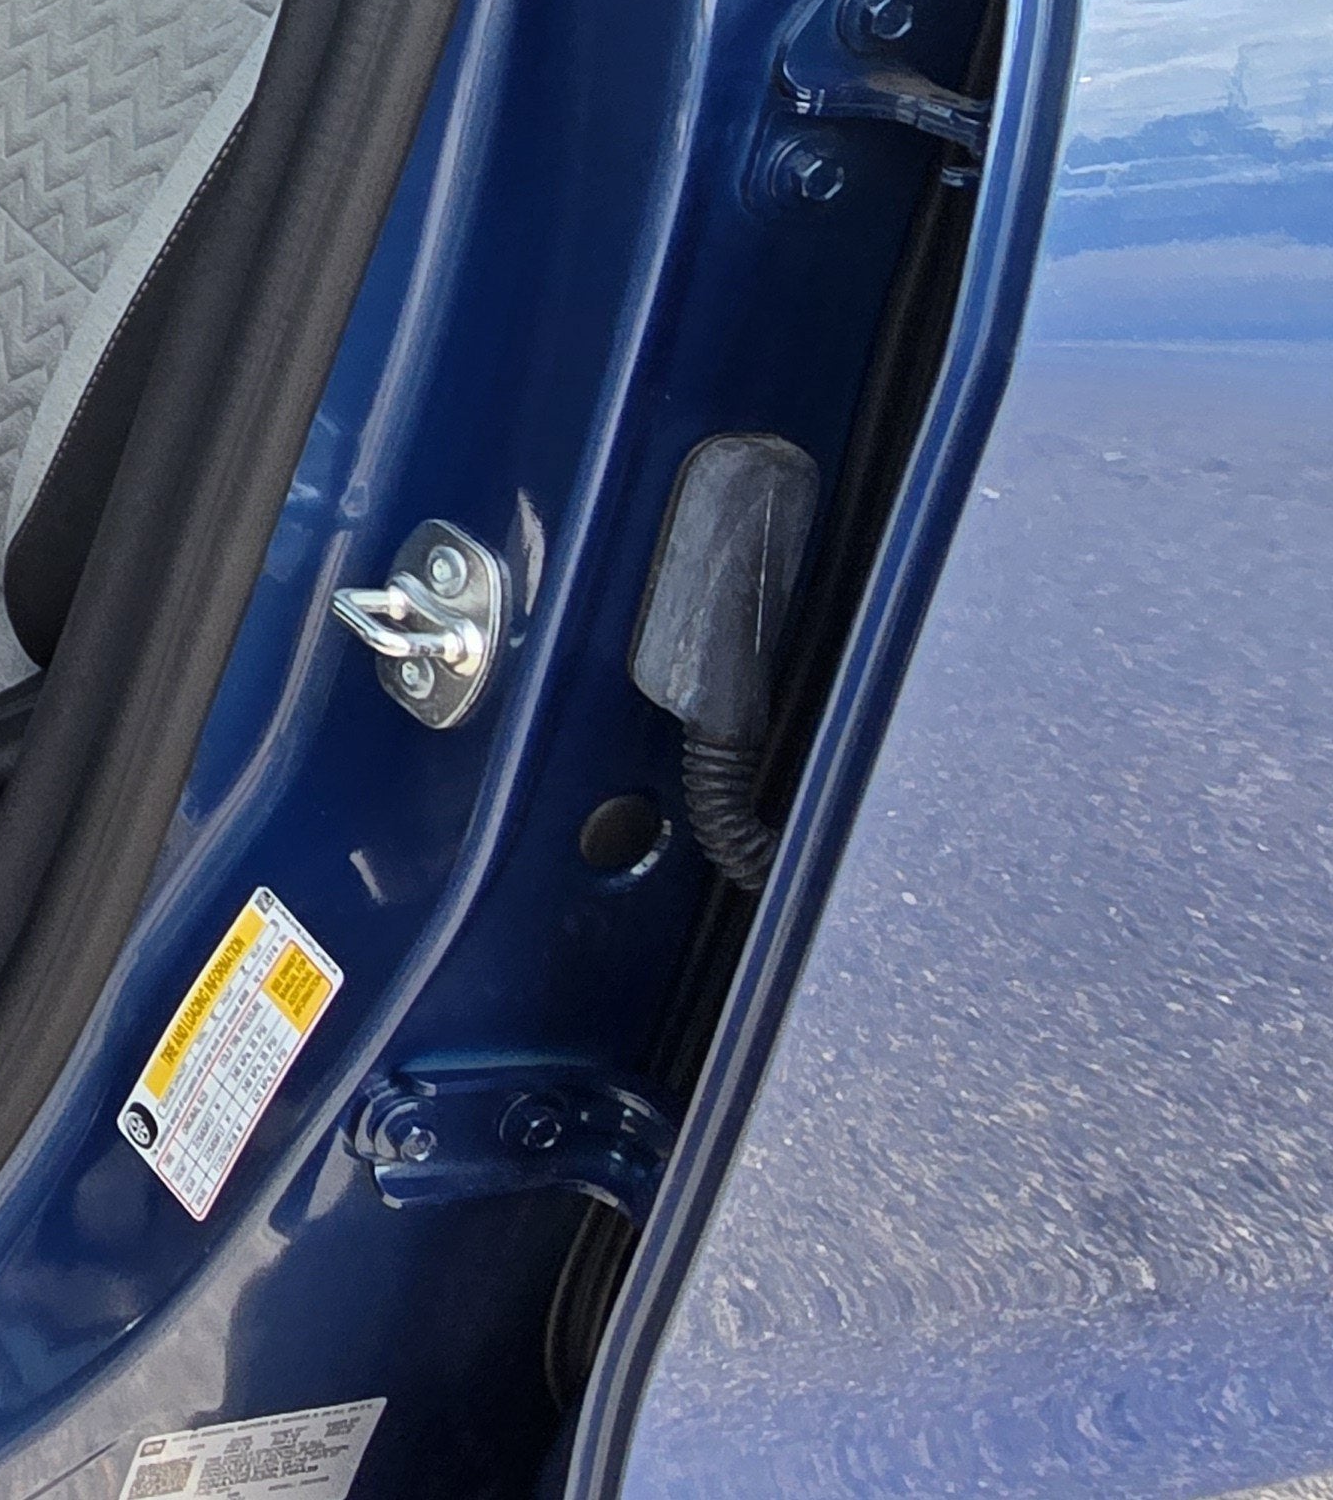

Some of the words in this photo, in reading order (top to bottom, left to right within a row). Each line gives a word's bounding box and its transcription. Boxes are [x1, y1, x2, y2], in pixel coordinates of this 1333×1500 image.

[160, 1041, 178, 1067] TIRE
[170, 1022, 189, 1048] AND
[180, 987, 210, 1032] LOADING
[202, 932, 245, 996] INFORMATION
